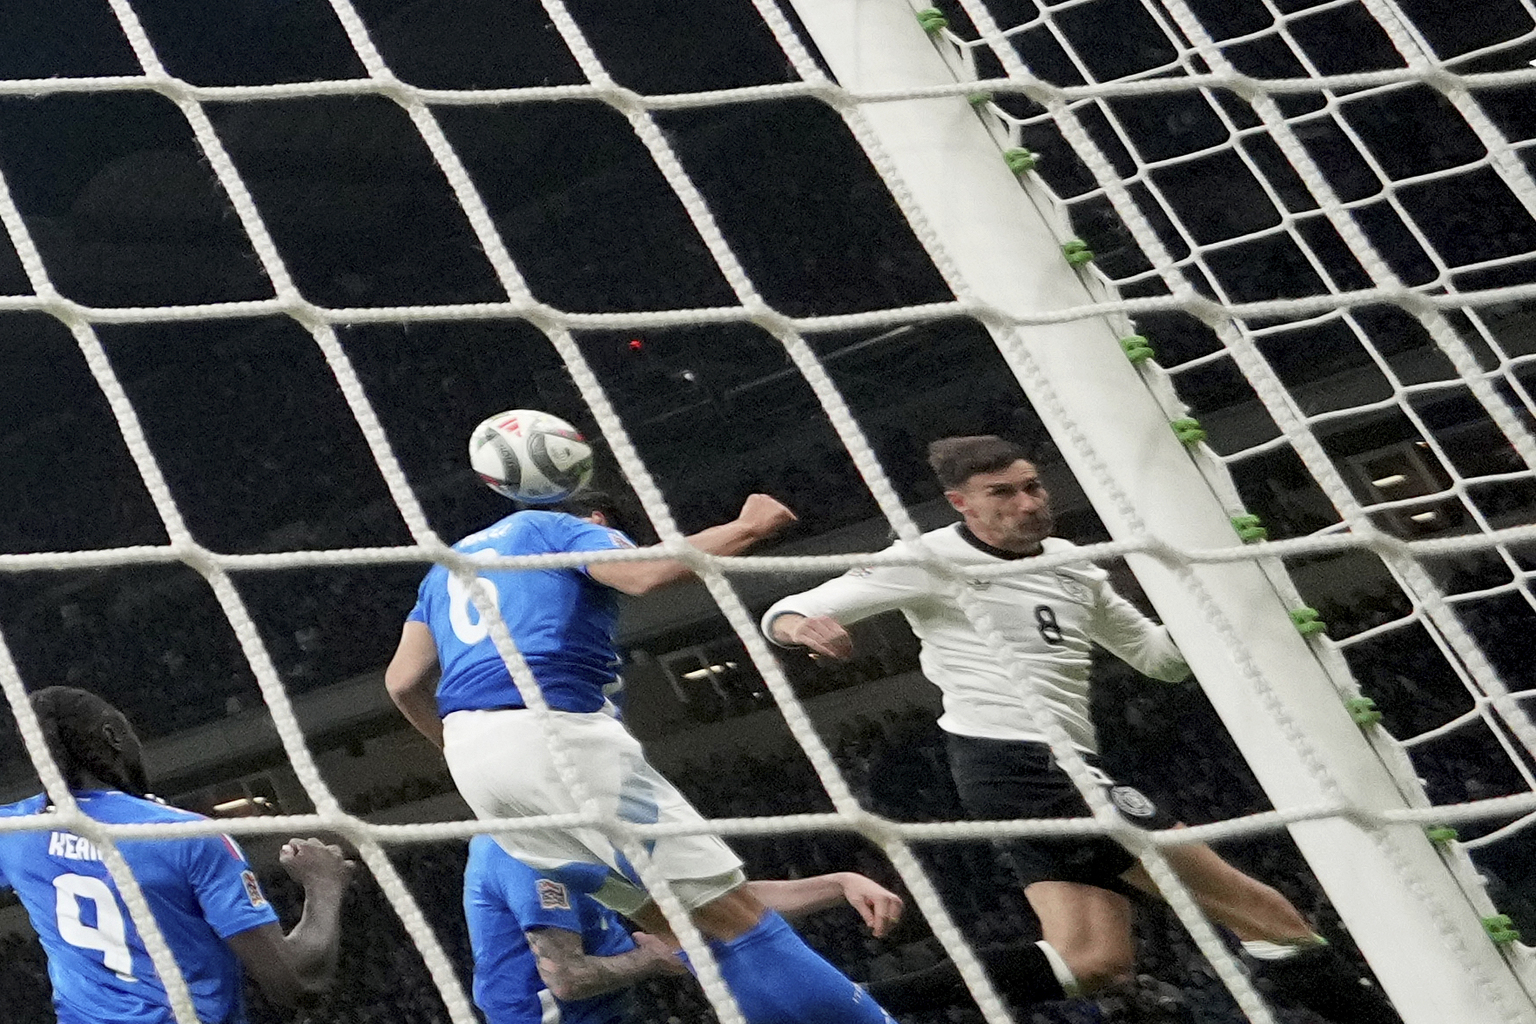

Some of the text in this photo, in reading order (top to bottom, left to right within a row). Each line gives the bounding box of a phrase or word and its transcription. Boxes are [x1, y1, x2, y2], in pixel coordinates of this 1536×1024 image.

[447, 547, 499, 645] 6
[1034, 604, 1064, 646] 8
[52, 873, 138, 983] 9
